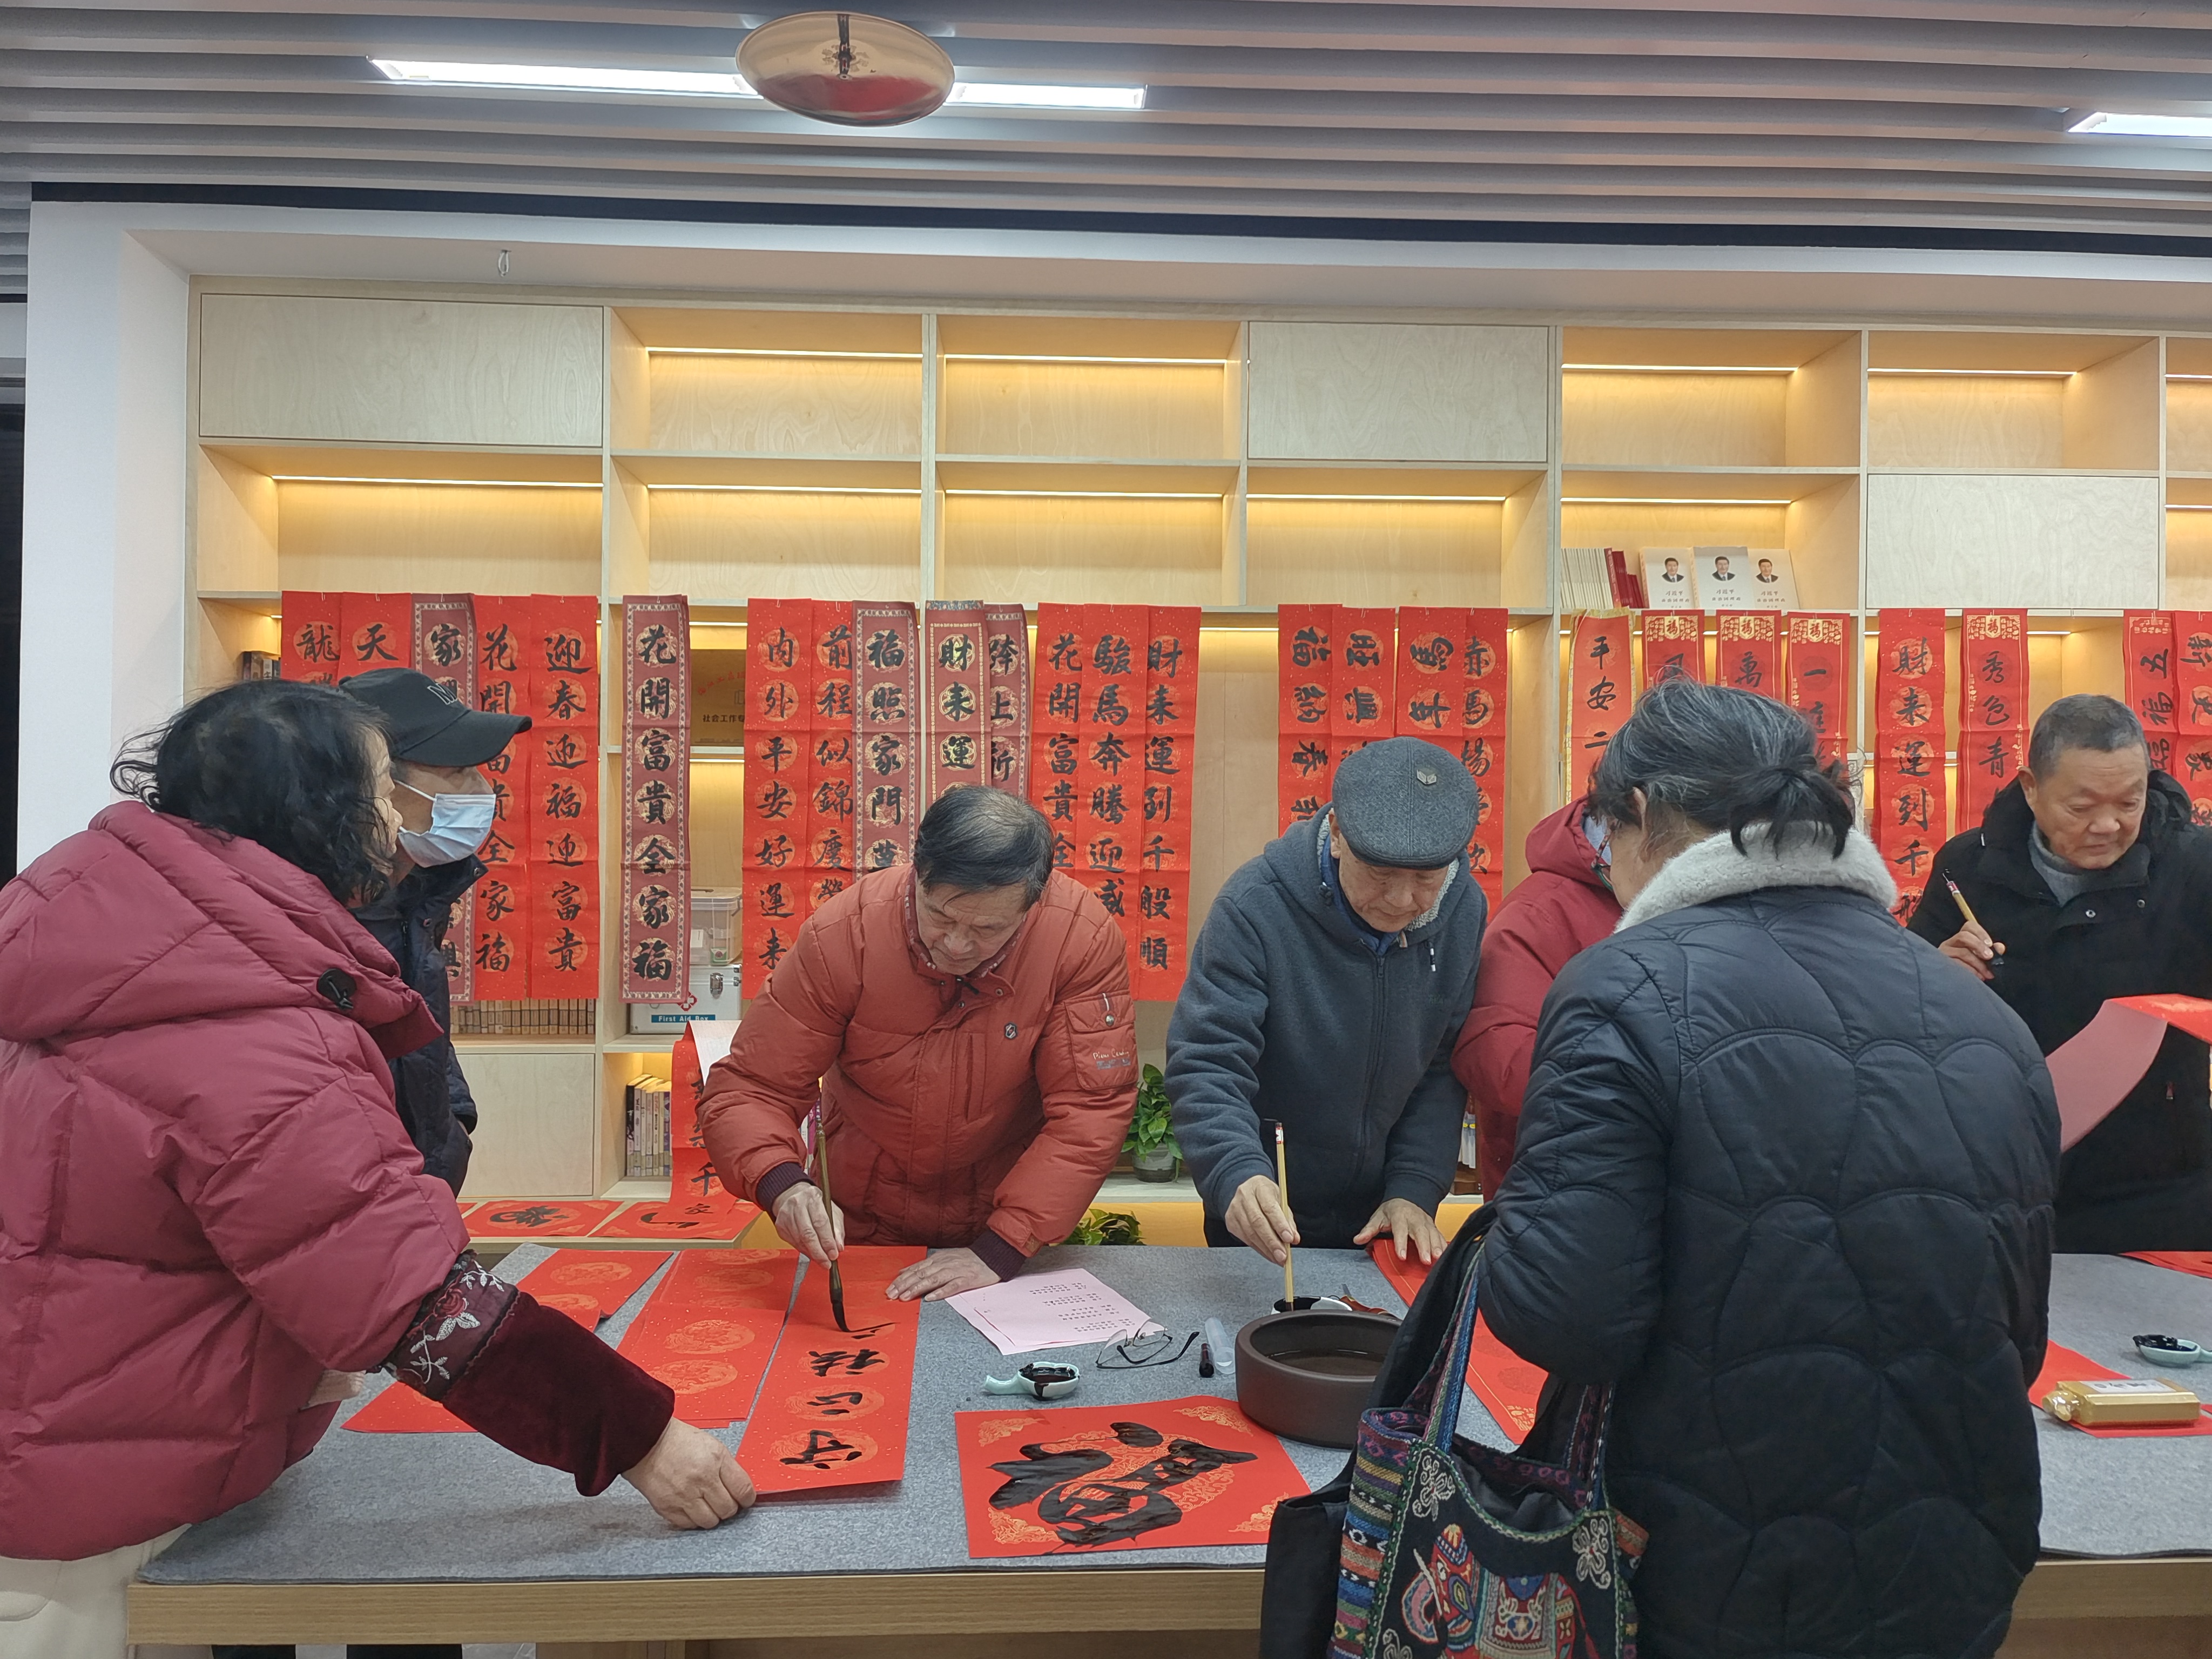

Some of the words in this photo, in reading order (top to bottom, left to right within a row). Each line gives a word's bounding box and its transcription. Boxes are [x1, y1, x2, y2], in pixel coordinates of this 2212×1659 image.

[631, 624, 677, 981] 花開富貴全家福
